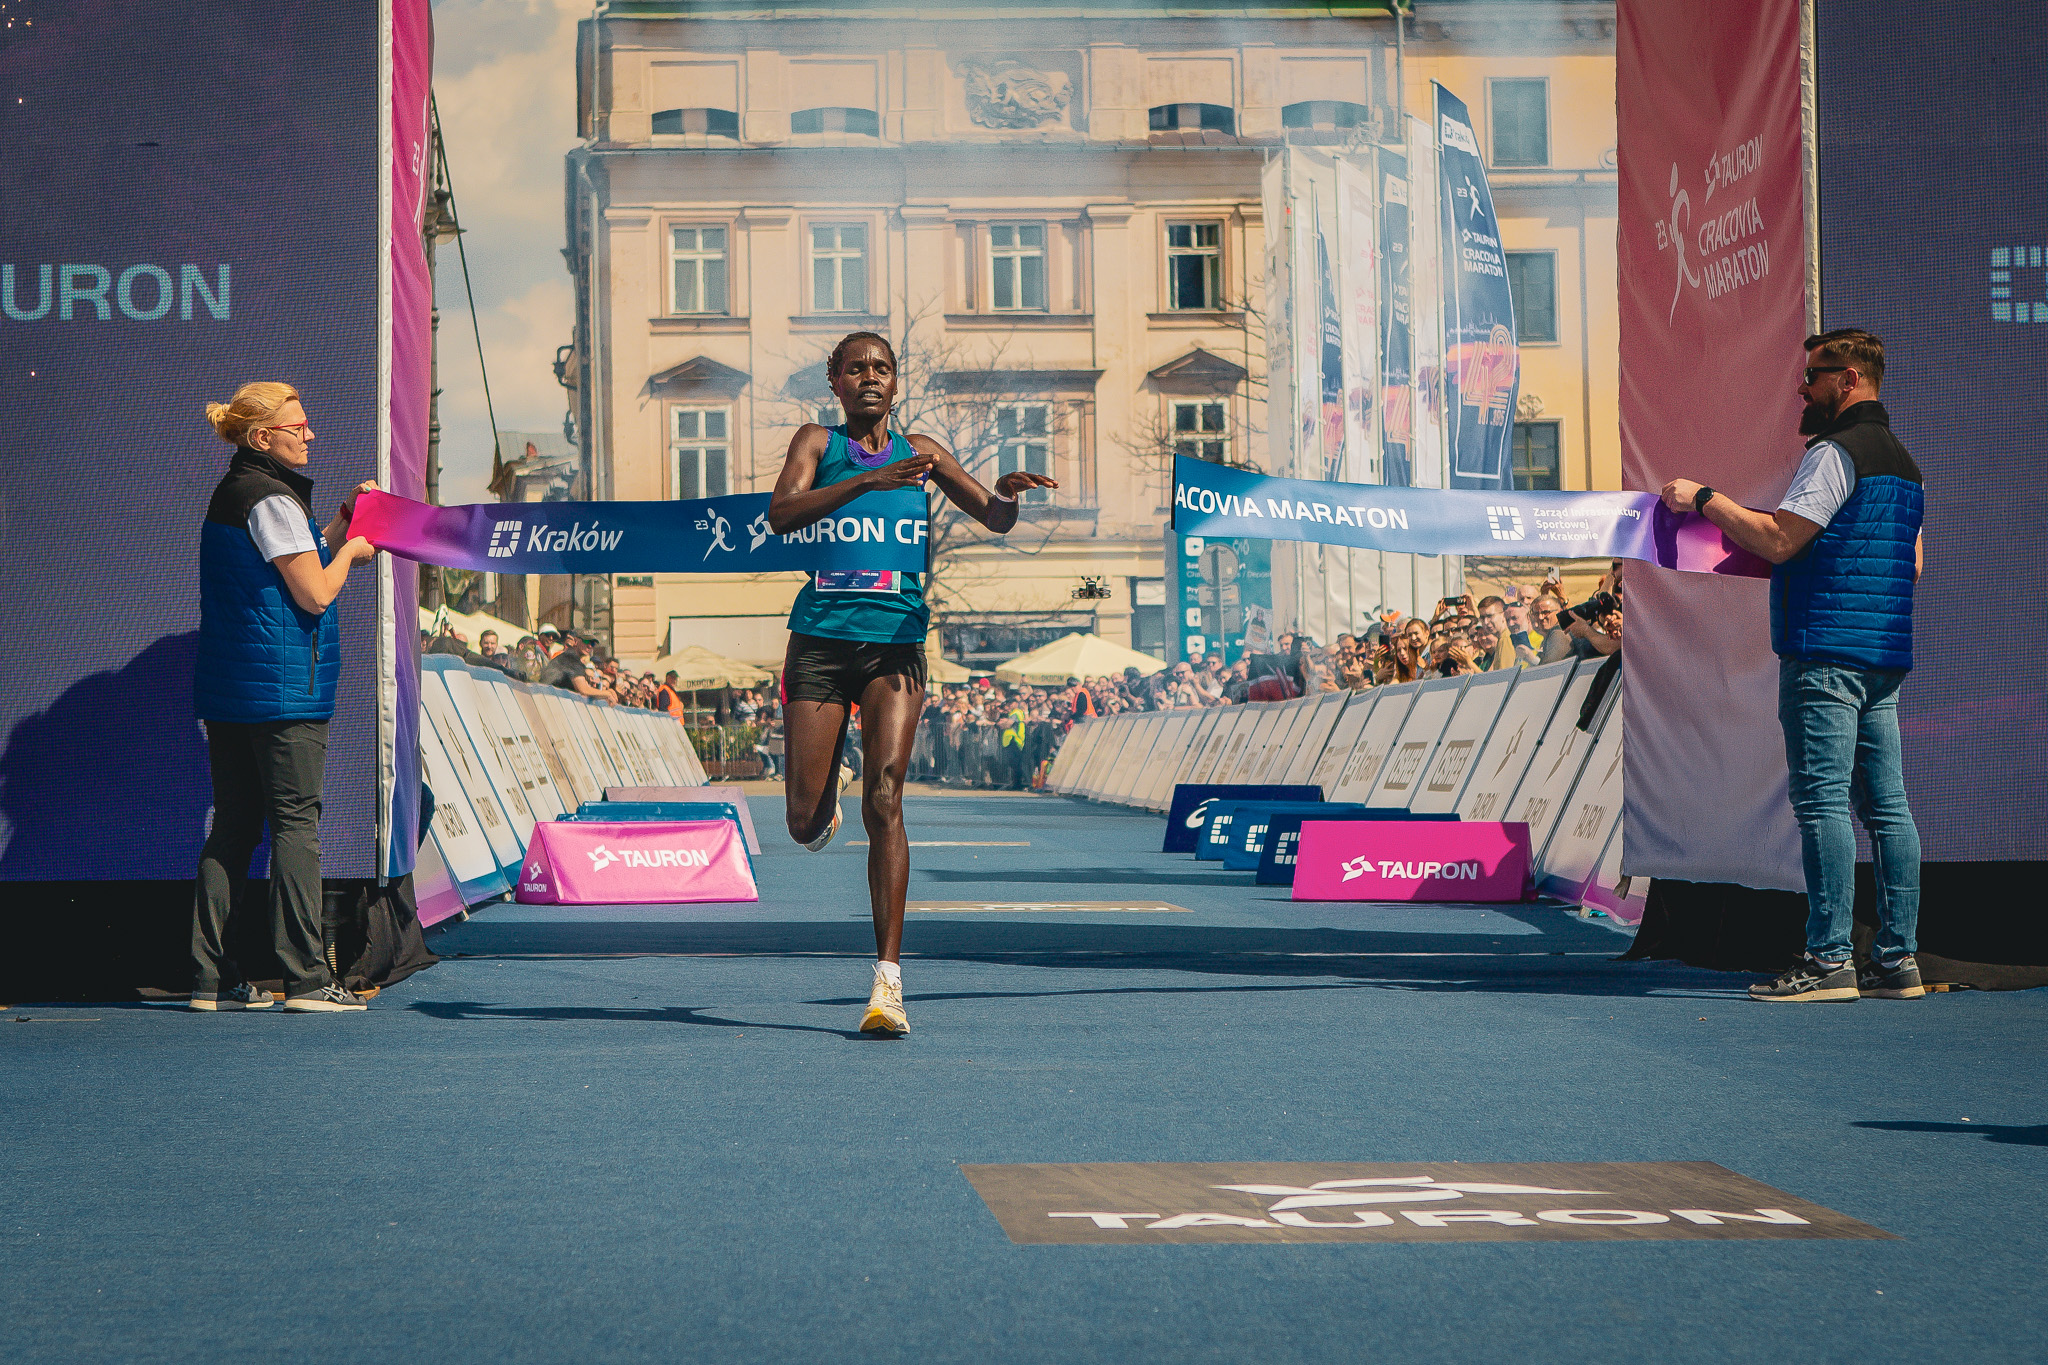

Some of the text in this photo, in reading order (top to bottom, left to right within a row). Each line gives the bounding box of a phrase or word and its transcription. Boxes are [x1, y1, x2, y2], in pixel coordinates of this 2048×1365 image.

[1721, 133, 1763, 188] TAURON
[1456, 187, 1467, 198] 23
[1655, 219, 1669, 250] 23
[1698, 196, 1765, 257] CRACOVIA
[1463, 260, 1503, 278] MARATON
[1703, 239, 1769, 300] MARATON
[1174, 482, 1409, 530] ACOVIA MARATON
[1532, 507, 1641, 520] Zarząd Infrastruktury
[693, 519, 709, 531] 23
[1536, 519, 1590, 531] Sportowej
[526, 520, 624, 553] Kraków
[1538, 531, 1599, 541] w Krakowie
[1572, 803, 1608, 841] TAURON
[618, 849, 710, 868] TAURON
[1377, 860, 1478, 880] TAURON
[523, 882, 547, 893] TAURON
[1047, 1208, 1812, 1230] TAURON
